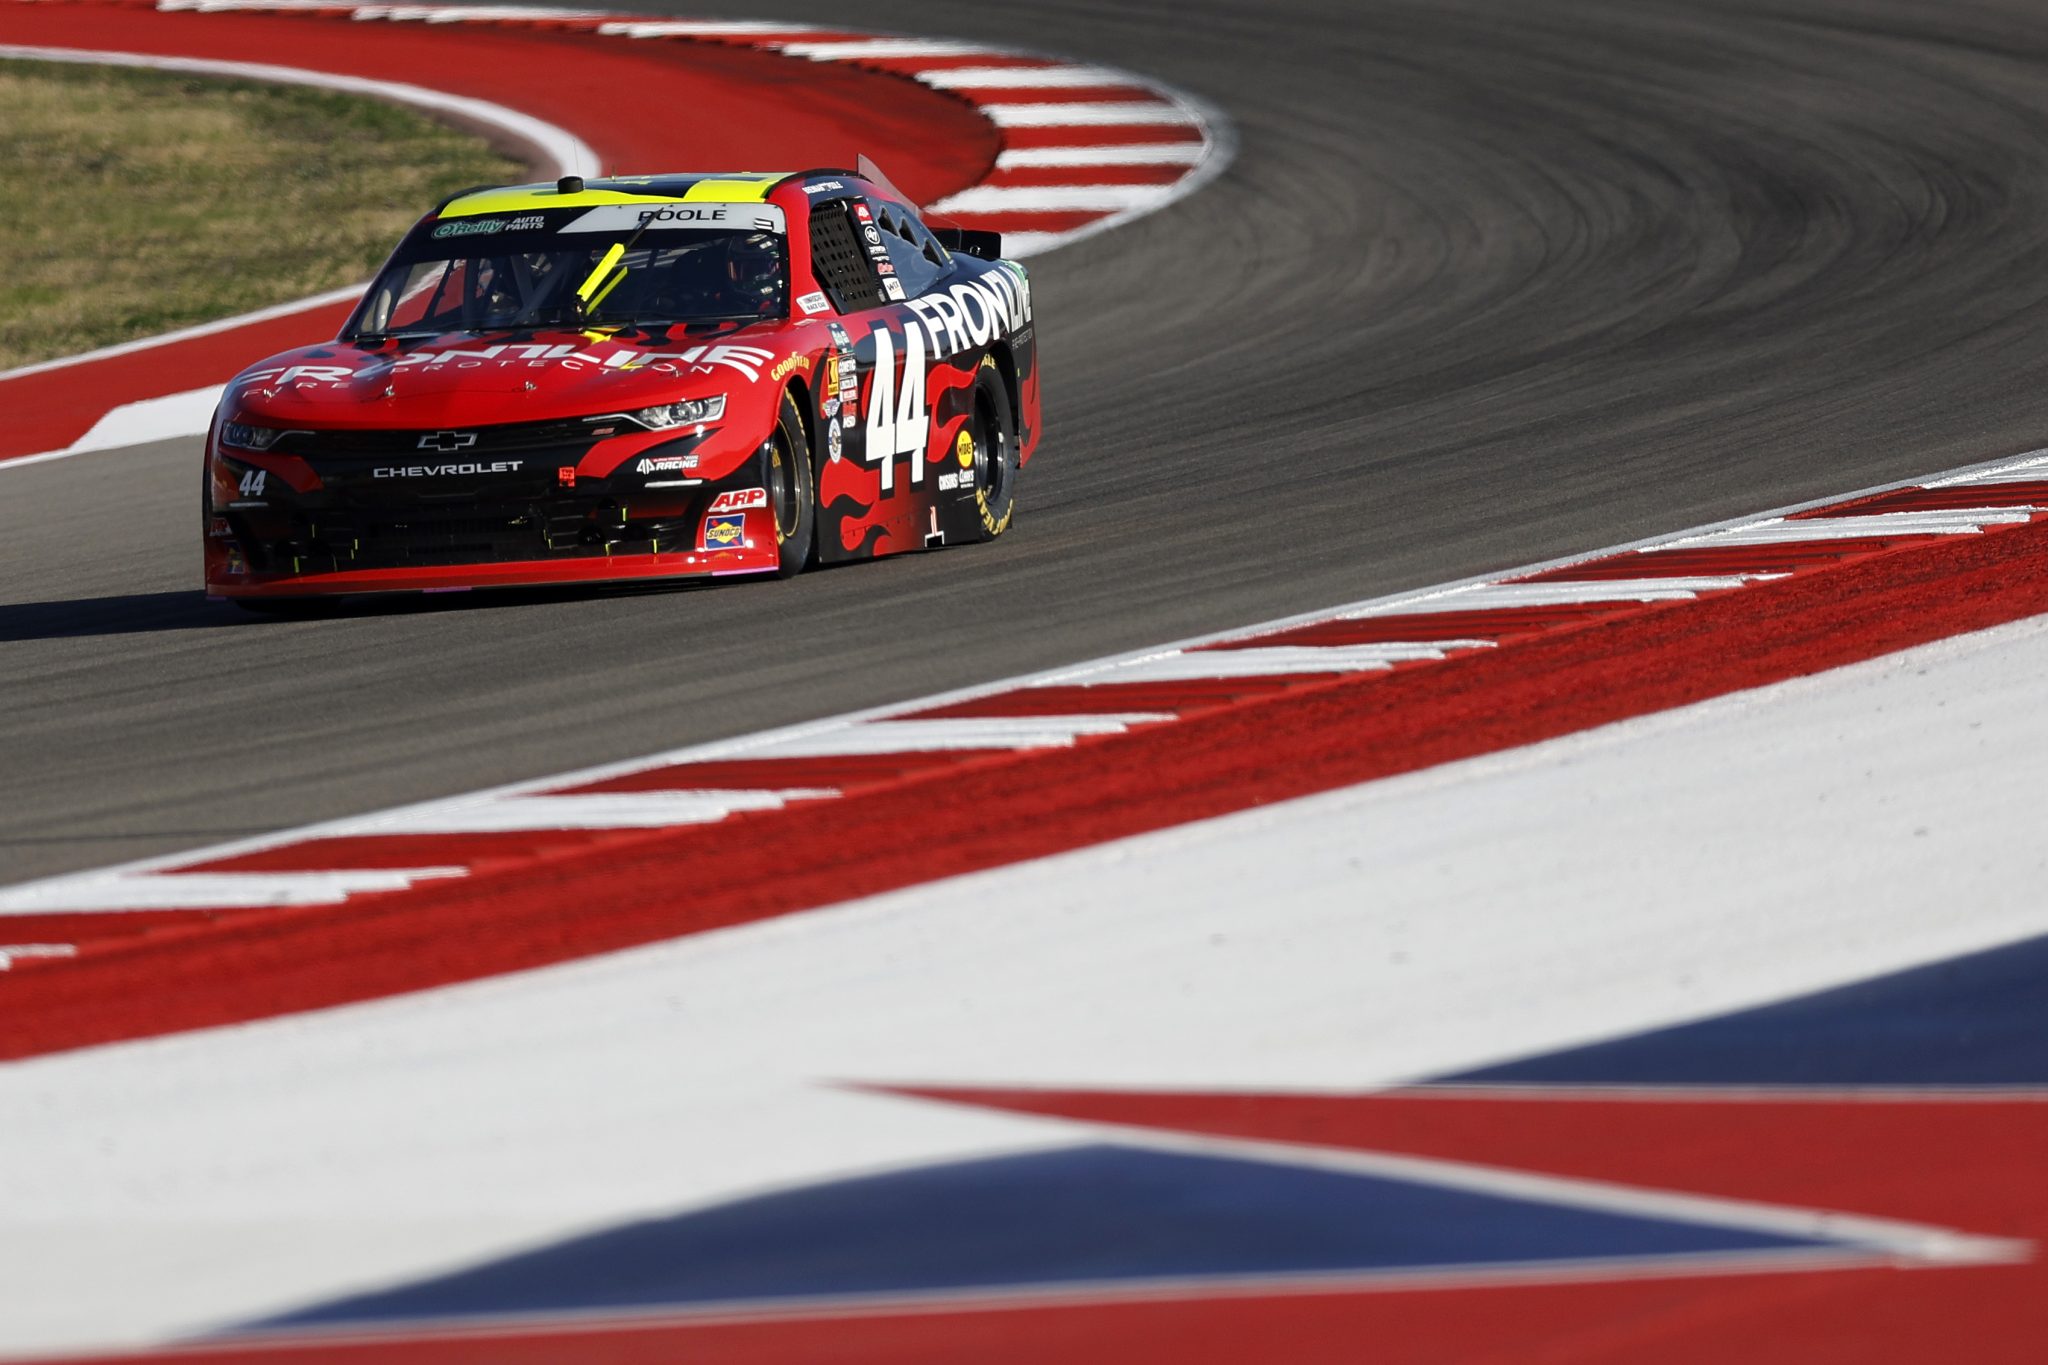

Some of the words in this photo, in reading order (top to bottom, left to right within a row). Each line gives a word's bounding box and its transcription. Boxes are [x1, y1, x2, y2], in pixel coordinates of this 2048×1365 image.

[512, 215, 545, 224] AUTO
[638, 209, 727, 221] POOLE
[433, 219, 504, 238] O'Reilly
[504, 222, 545, 231] PARTS
[391, 358, 715, 376] PROTECTION
[770, 351, 810, 382] GOODYEAR
[865, 320, 929, 491] 44
[373, 460, 523, 478] CHEVROLET
[655, 459, 699, 471] RACING
[239, 470, 267, 496] 44
[713, 489, 766, 508] ARP
[708, 526, 741, 538] SUNOCO
